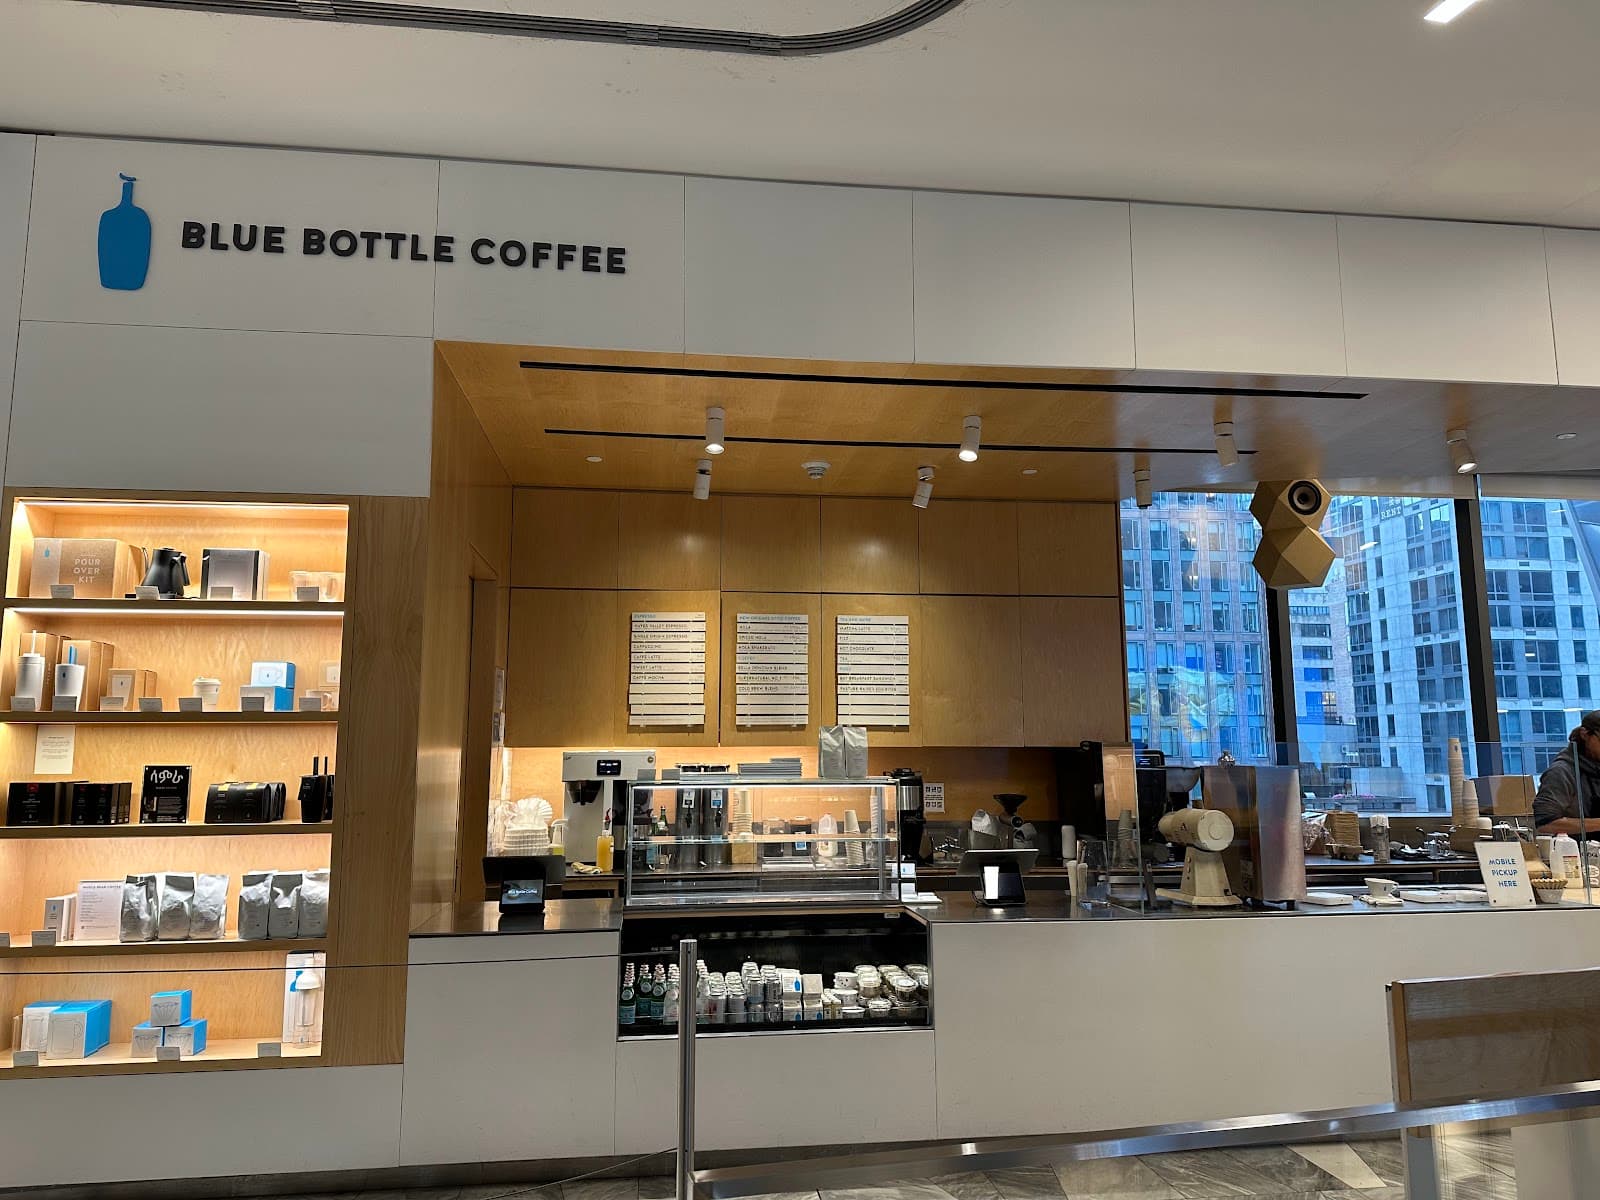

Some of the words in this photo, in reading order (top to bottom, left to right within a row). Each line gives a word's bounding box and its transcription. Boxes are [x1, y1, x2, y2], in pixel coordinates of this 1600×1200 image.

[182, 221, 286, 254] BLUE
[302, 228, 454, 263] BOTTLE
[470, 238, 626, 274] COFFEE
[1380, 506, 1402, 520] RENT
[74, 558, 101, 566] POUR
[73, 567, 101, 575] OVER
[78, 576, 95, 584] KIT
